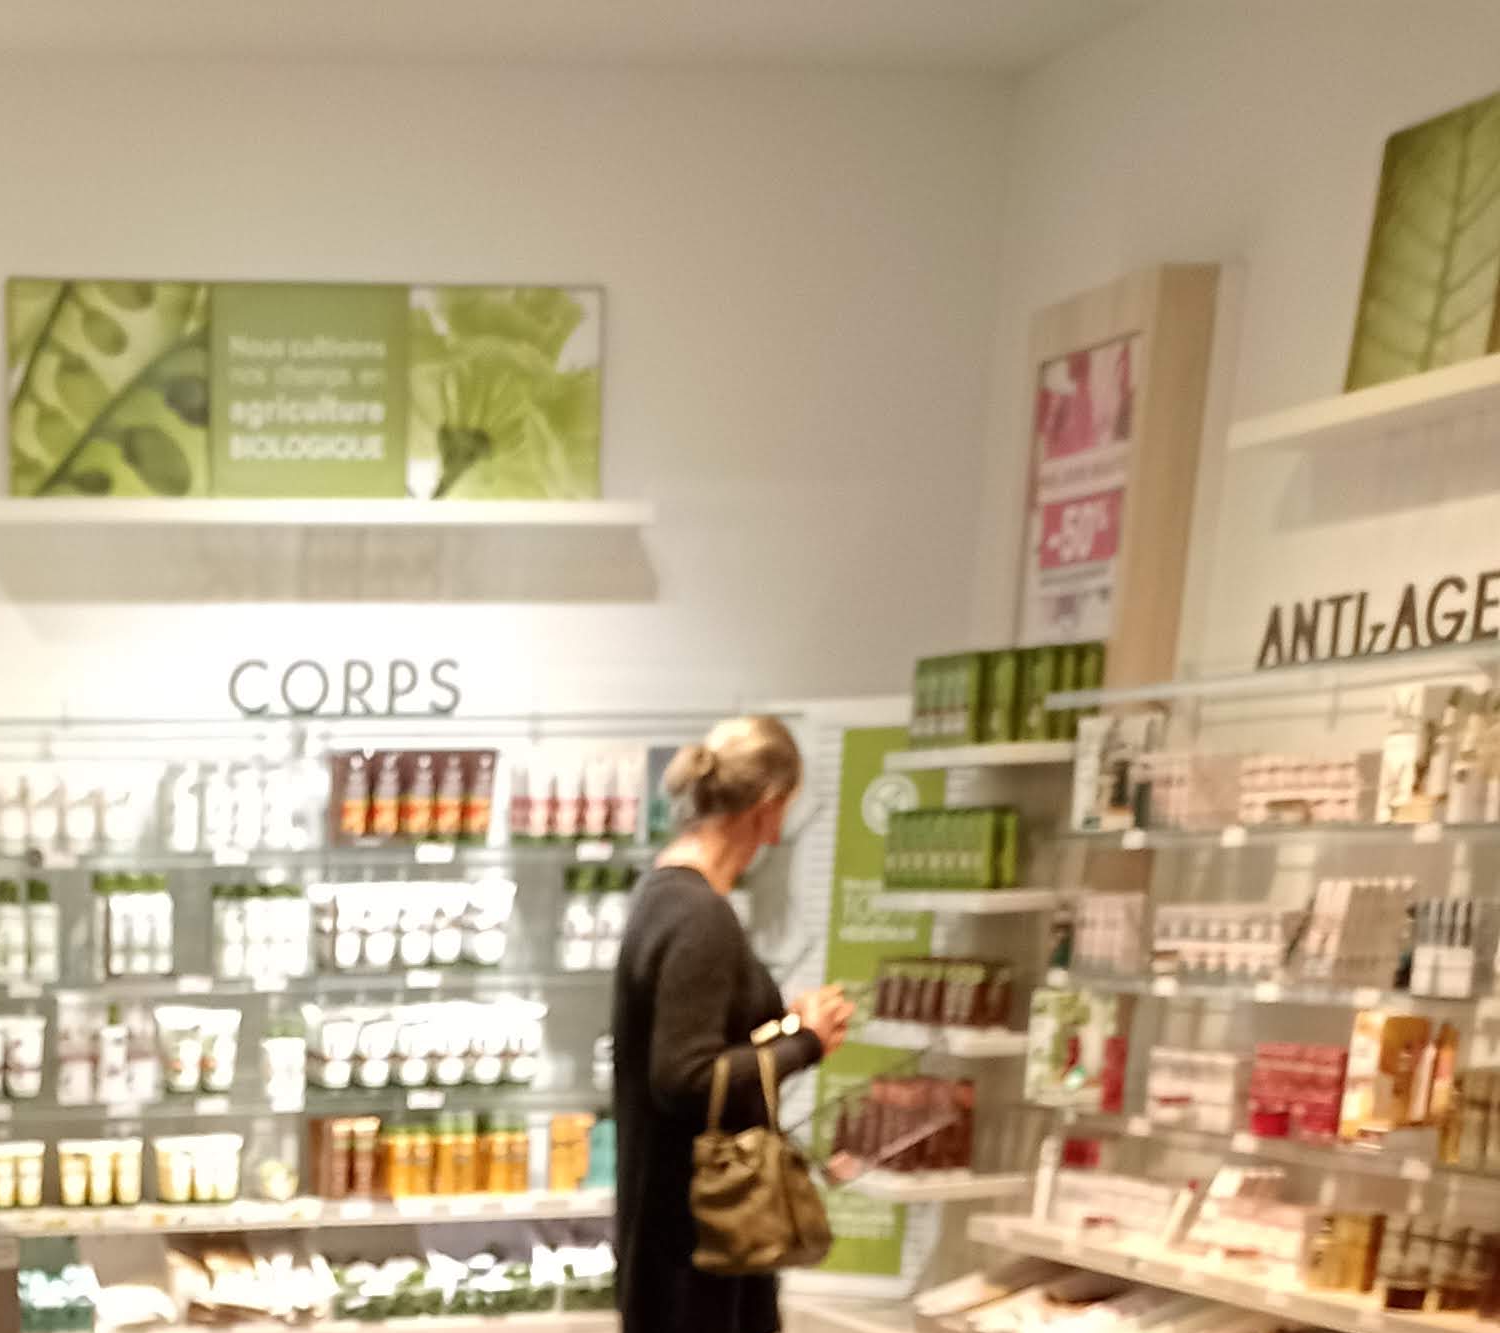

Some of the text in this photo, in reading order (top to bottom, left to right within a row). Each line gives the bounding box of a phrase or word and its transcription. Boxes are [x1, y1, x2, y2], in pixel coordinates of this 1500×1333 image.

[229, 394, 385, 431] agriculture
[229, 434, 385, 461] BIOLOGIQUE
[228, 658, 461, 716] CORPS
